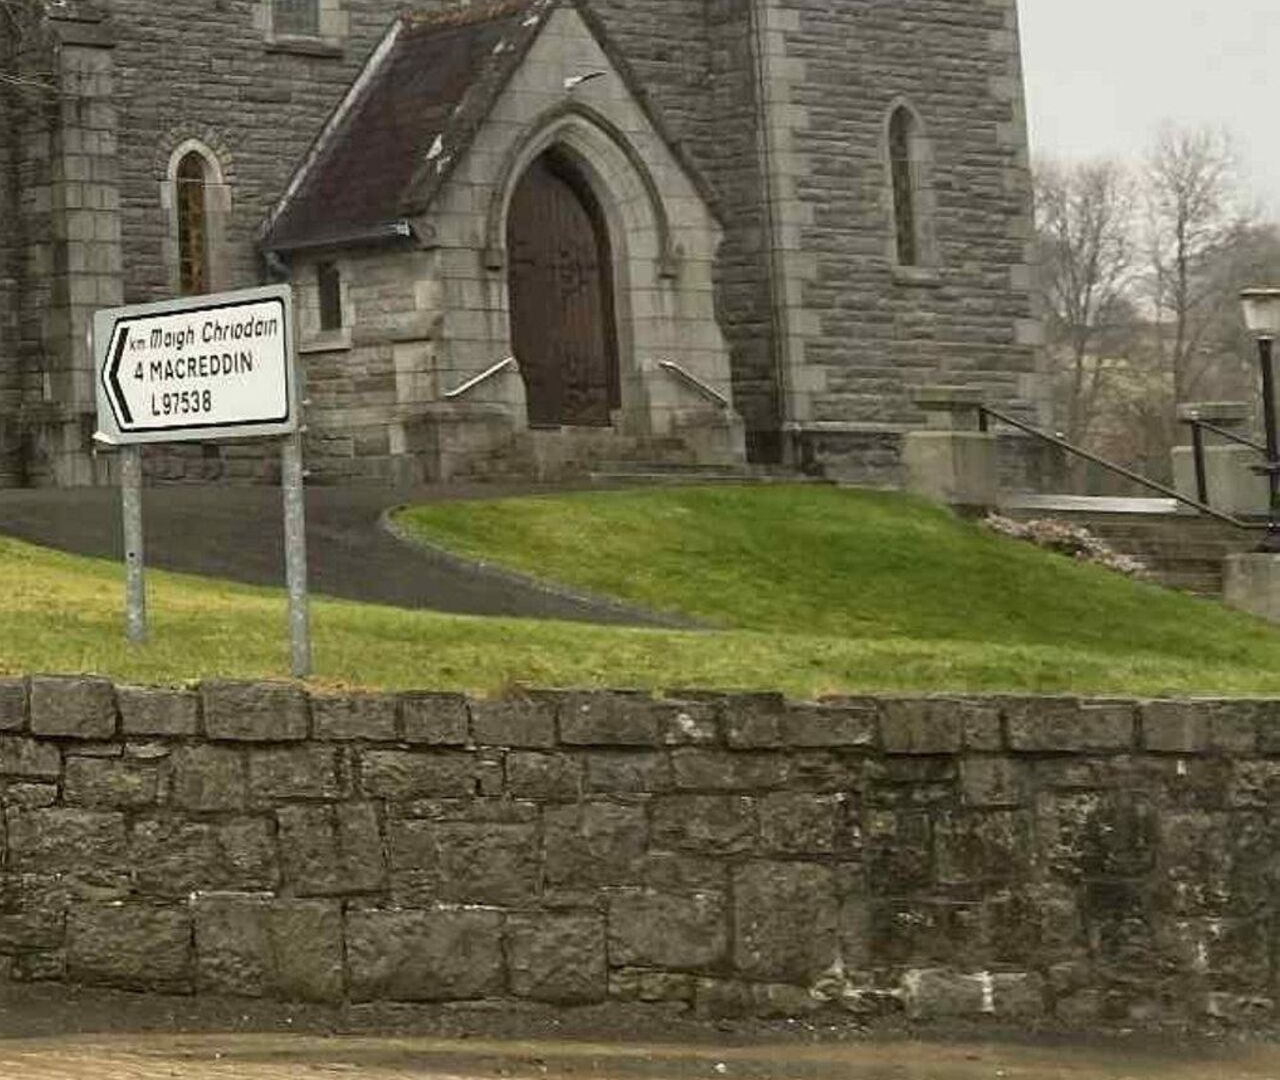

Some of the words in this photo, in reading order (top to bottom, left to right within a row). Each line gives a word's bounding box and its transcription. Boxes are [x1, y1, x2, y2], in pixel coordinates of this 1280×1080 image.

[150, 325, 195, 350] Maigh
[134, 360, 144, 381] 4
[150, 351, 253, 382] MACREDDIN
[151, 389, 212, 416] L97538
